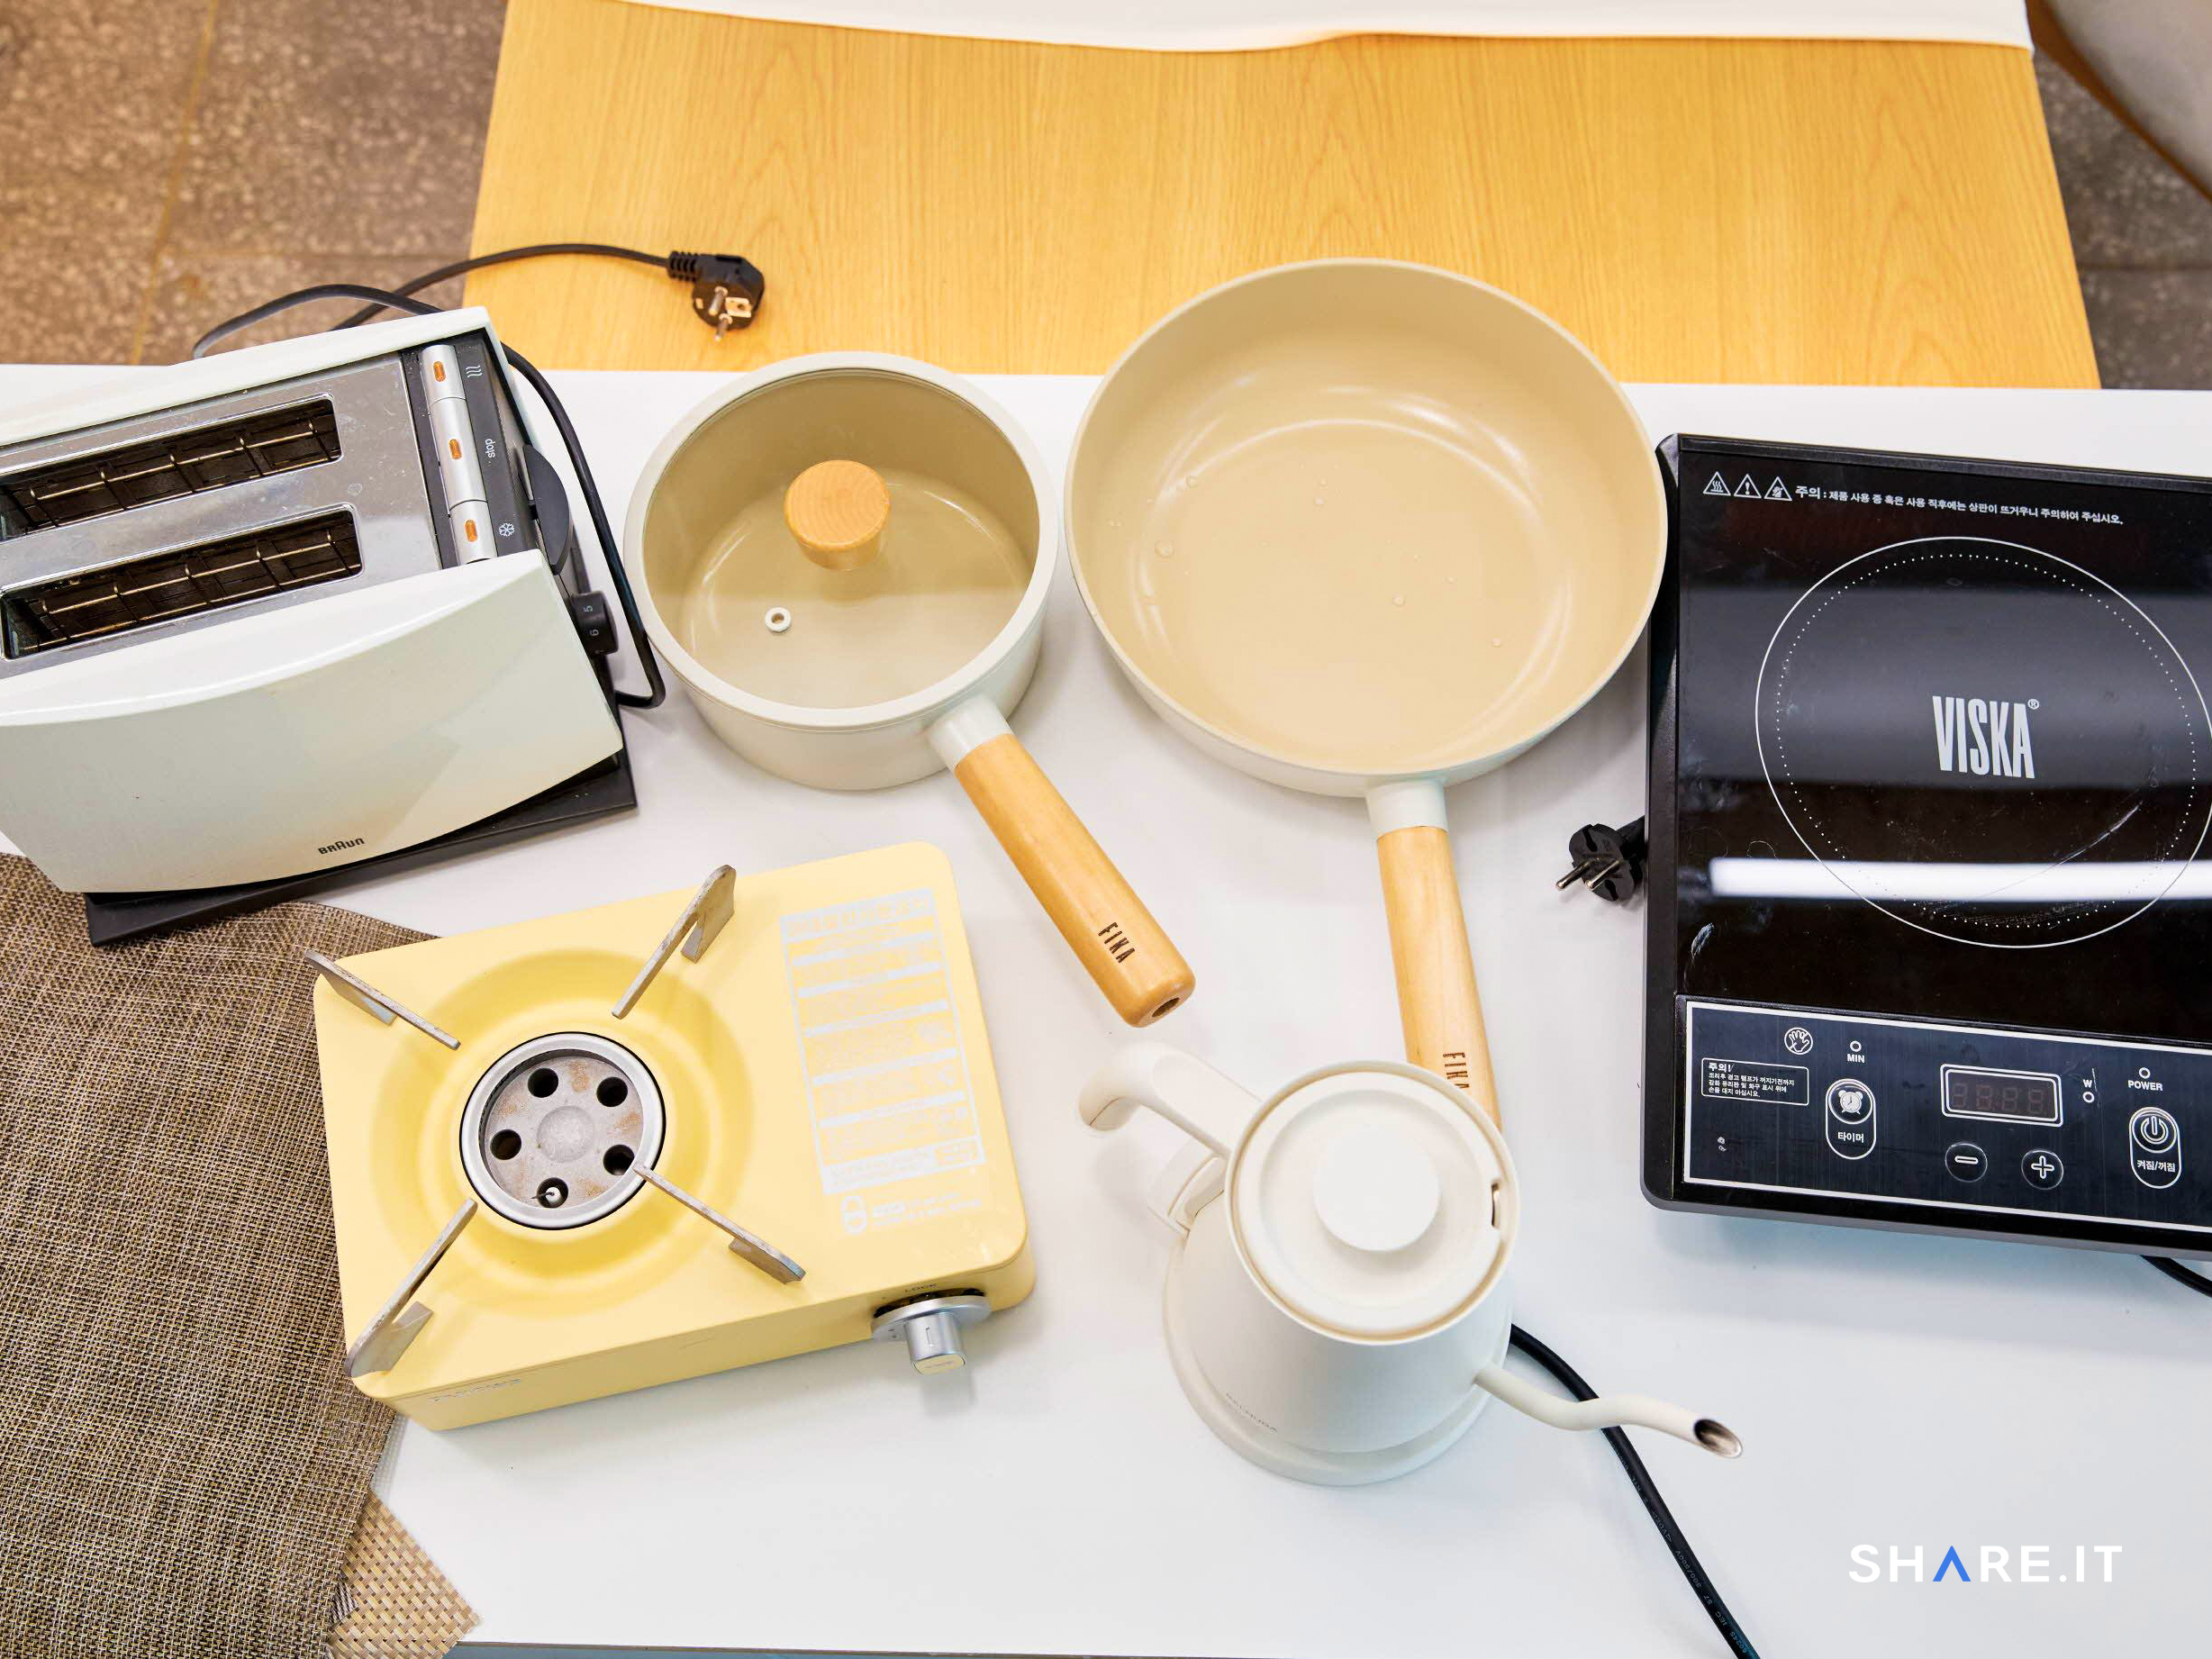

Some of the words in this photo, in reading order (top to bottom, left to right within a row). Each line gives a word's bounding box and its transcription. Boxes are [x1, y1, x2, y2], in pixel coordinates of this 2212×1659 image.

[485, 439, 496, 458] stop
[1795, 485, 1820, 499] 주의
[1828, 491, 1848, 502] 제품
[1850, 493, 1870, 503] 사용
[1872, 494, 1882, 504] 중
[1884, 495, 1904, 506] 혹은
[1906, 497, 1926, 508] 사용
[1927, 500, 1966, 512] 직후에는
[1968, 502, 1998, 514] 상판이
[1999, 506, 2038, 517] 뜨거우니
[2040, 508, 2079, 521] 주의하여
[2081, 512, 2124, 525] 주십시오.
[1098, 921, 1136, 964] FIKA
[1846, 1053, 1865, 1064] MIN
[1708, 1062, 1731, 1073] 주의!
[2082, 1079, 2092, 1089] W
[2127, 1080, 2163, 1092] POWER
[1837, 1131, 1864, 1143] 타이머
[2136, 1159, 2176, 1173] 켜짐/꺼짐
